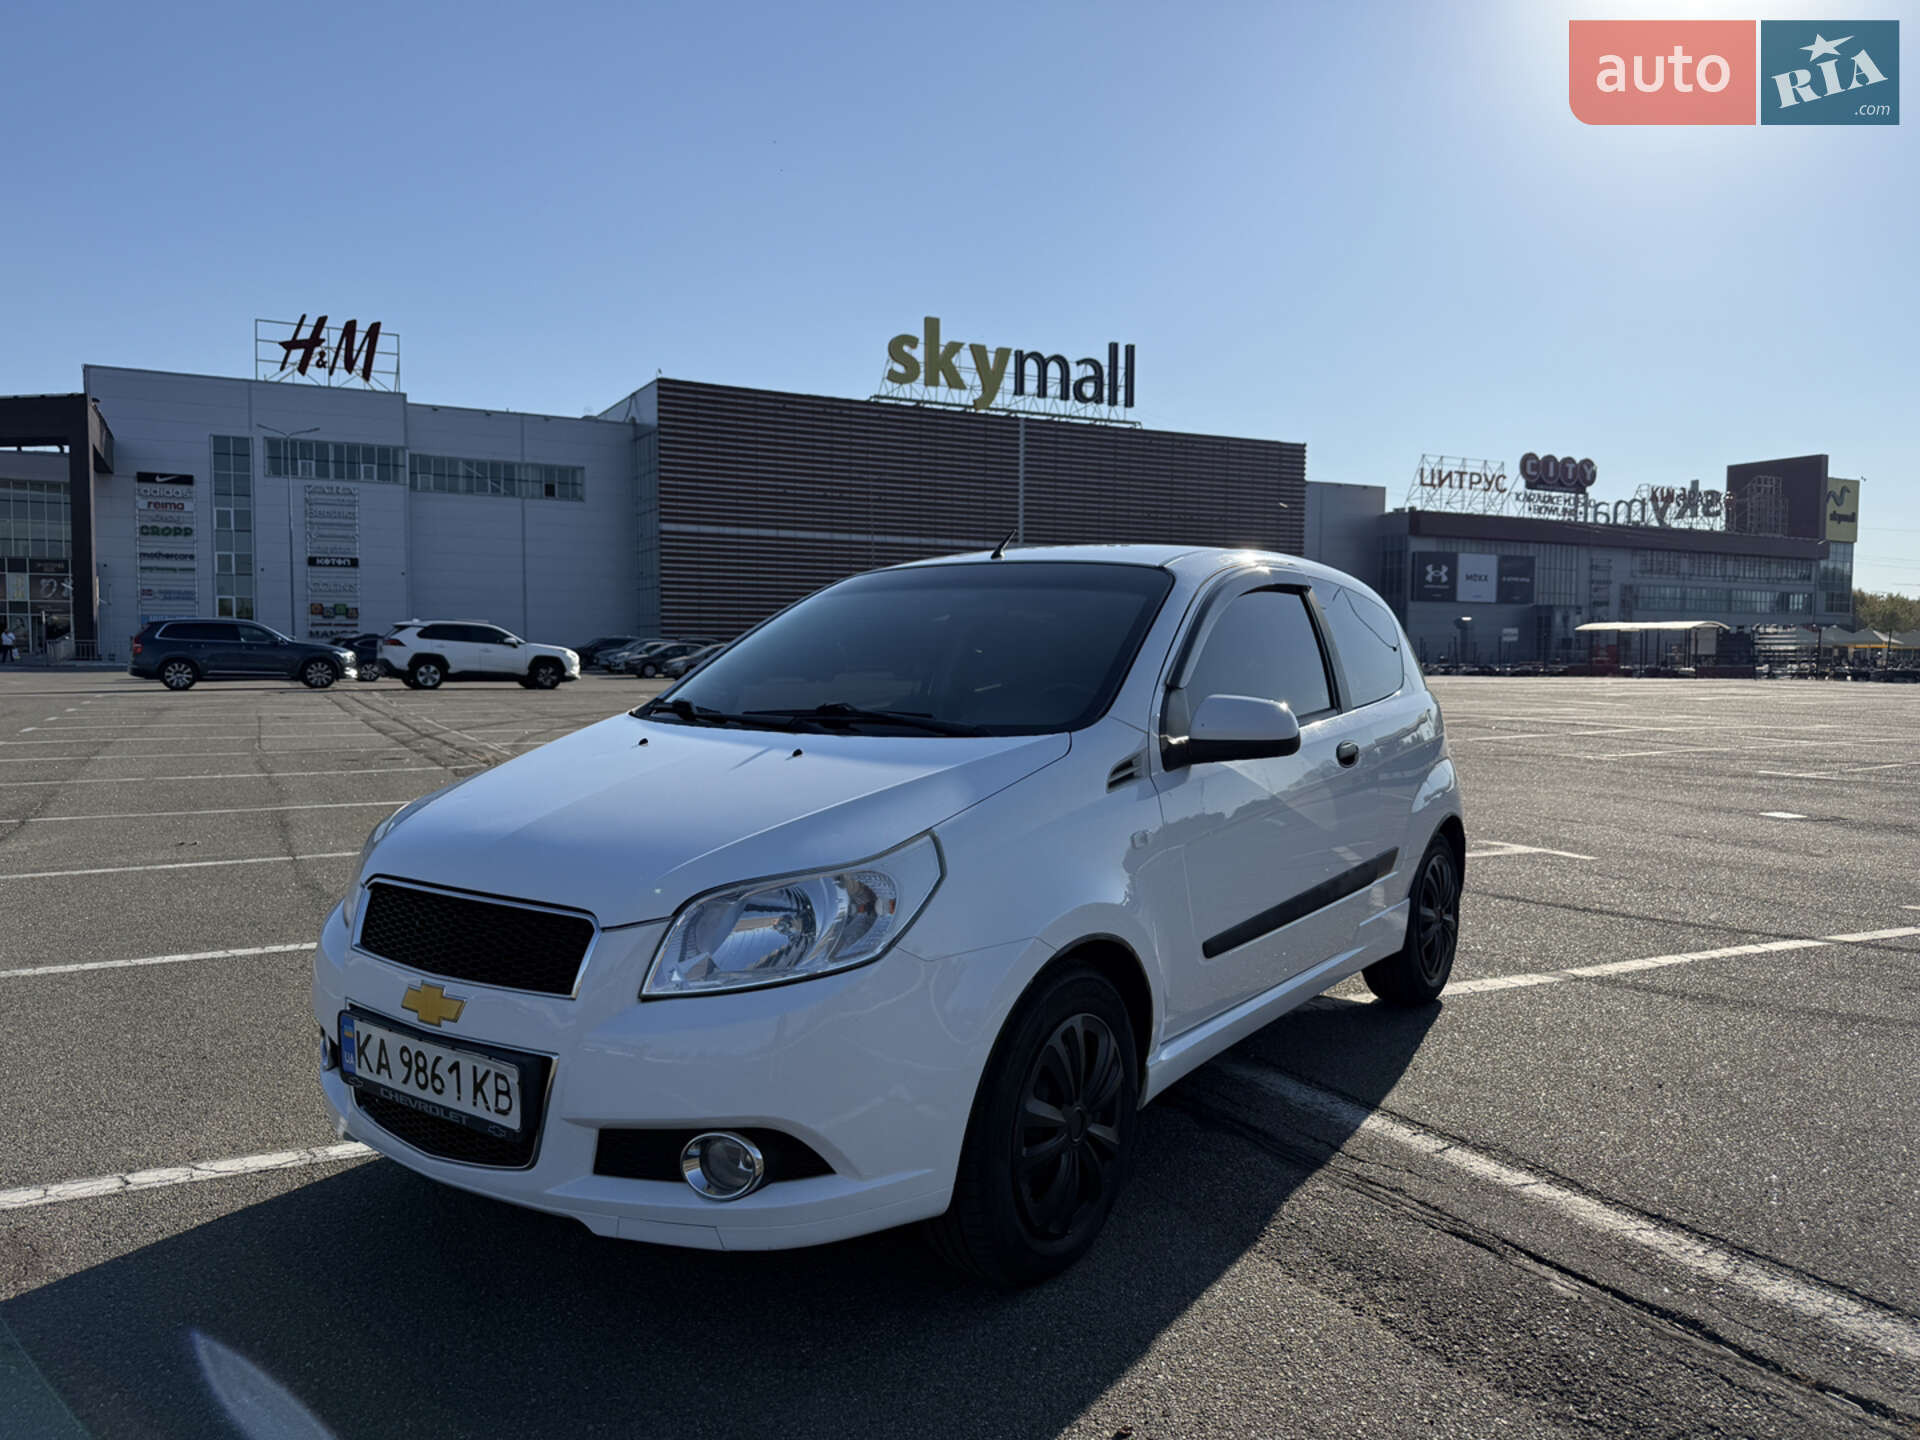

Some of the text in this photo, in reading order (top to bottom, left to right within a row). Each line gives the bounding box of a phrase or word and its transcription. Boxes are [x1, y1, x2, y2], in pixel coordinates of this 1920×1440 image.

[279, 313, 381, 383] H&M
[887, 316, 1136, 411] skymall
[1419, 467, 1508, 493] ЦИТРУС
[1526, 459, 1594, 483] CITY
[139, 487, 193, 498] adidas
[147, 501, 185, 511] reima
[140, 525, 193, 536] CROPP
[139, 550, 195, 560] mothercare
[356, 1030, 513, 1117] KA 9861 KB
[379, 1087, 469, 1126] CHEVROLET
